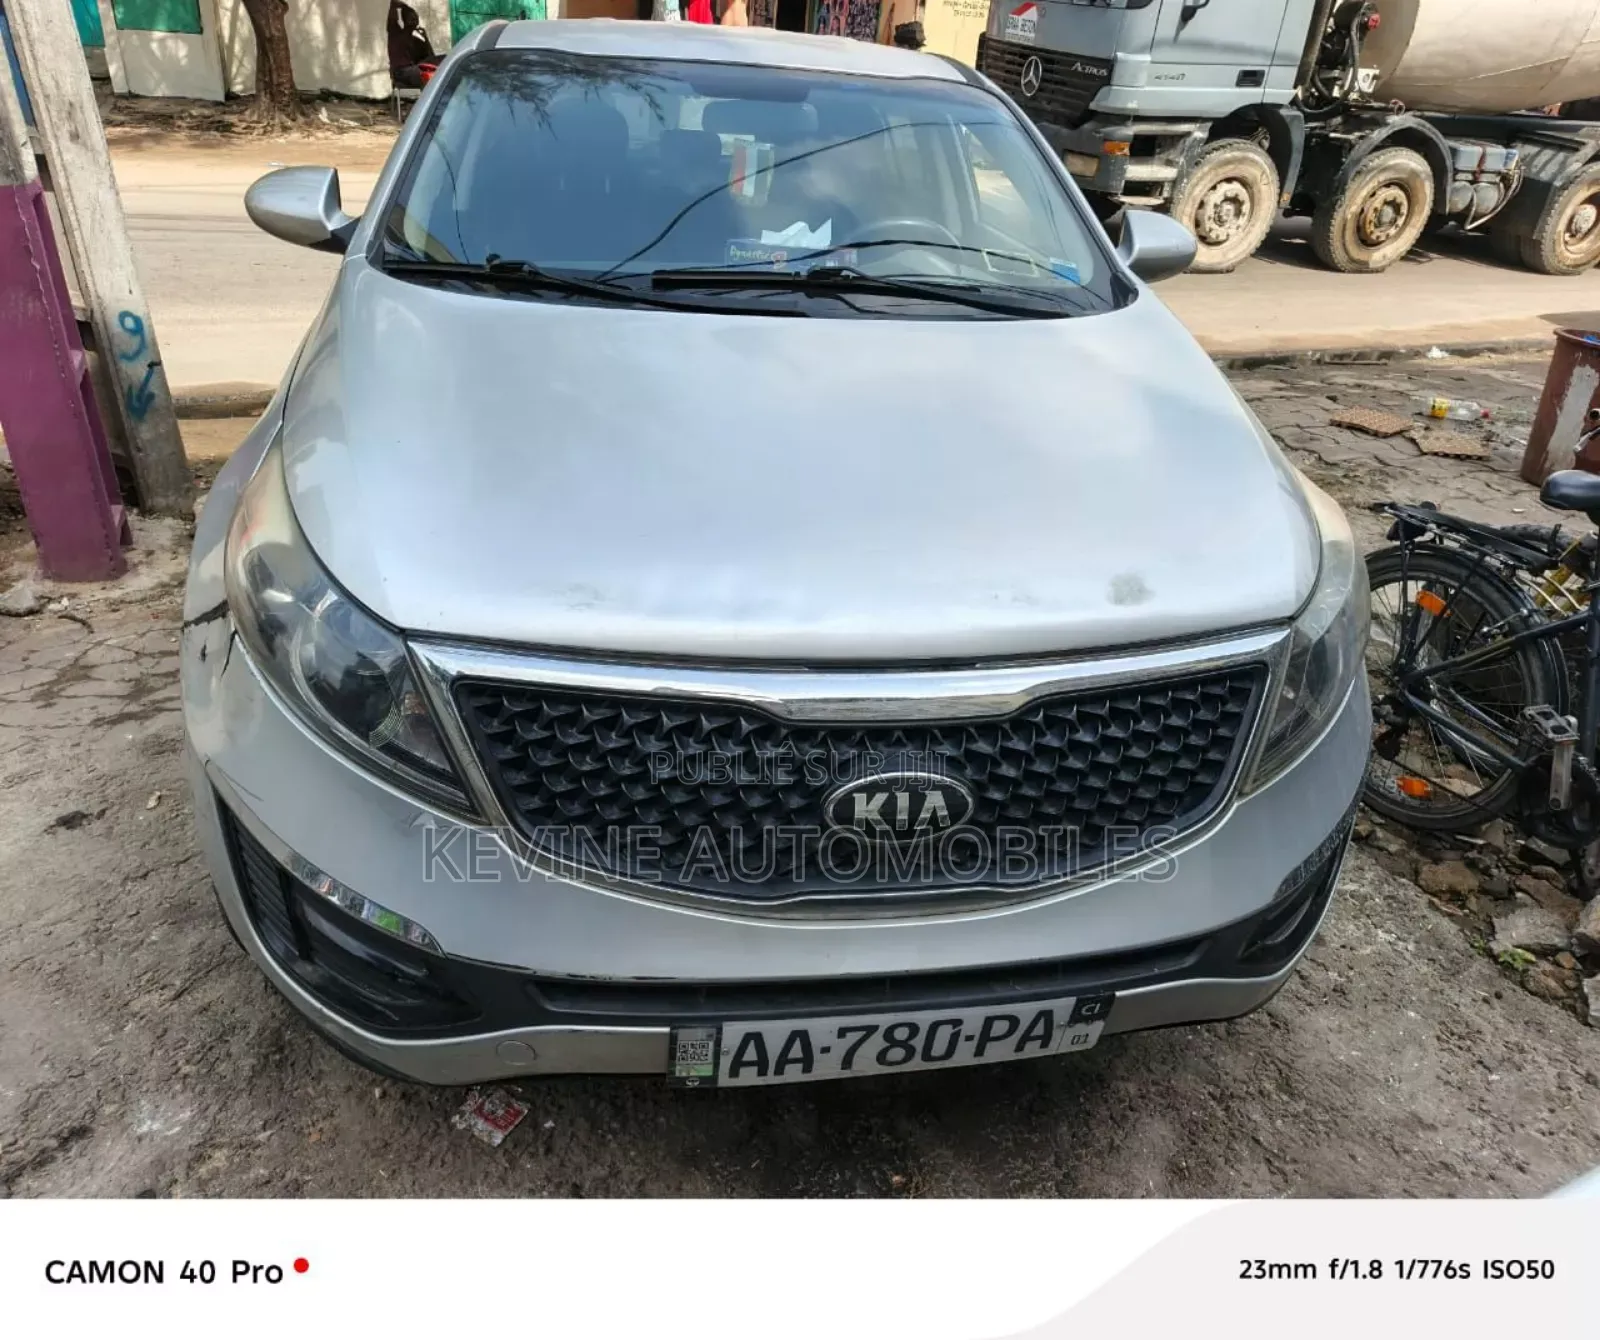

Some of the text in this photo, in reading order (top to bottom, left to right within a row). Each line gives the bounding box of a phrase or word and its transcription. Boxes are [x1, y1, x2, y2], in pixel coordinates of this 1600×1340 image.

[118, 310, 147, 361] 9
[853, 790, 951, 831] KIA
[1081, 1003, 1100, 1016] CI
[728, 1009, 1054, 1079] AA-780-PA
